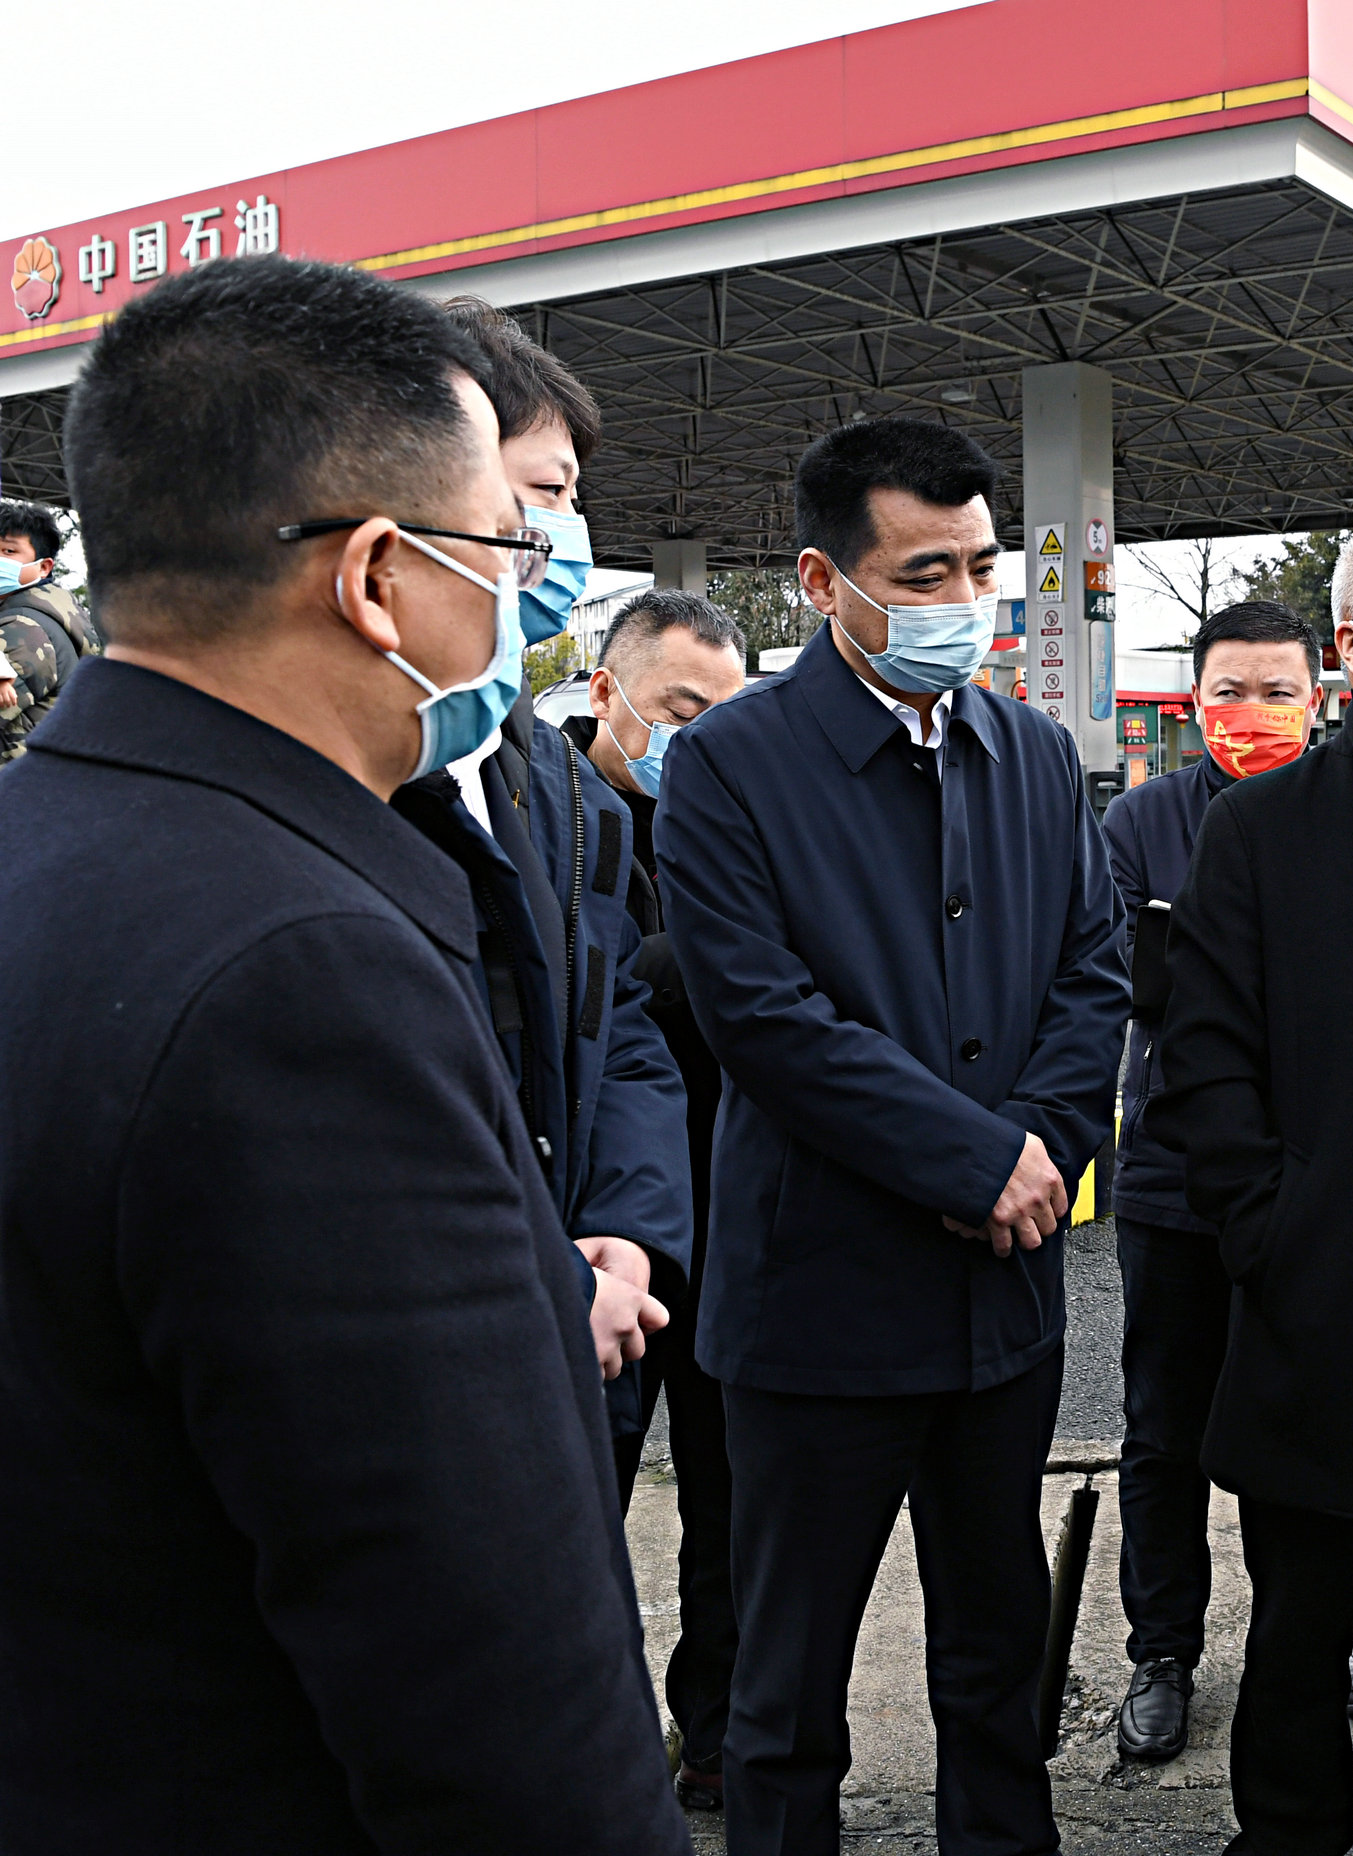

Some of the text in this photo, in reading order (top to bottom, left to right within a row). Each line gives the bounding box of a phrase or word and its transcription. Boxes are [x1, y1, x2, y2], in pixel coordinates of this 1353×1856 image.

[79, 194, 279, 293] 中国石油
[1097, 569, 1112, 585] 92
[1015, 610, 1025, 625] 4
